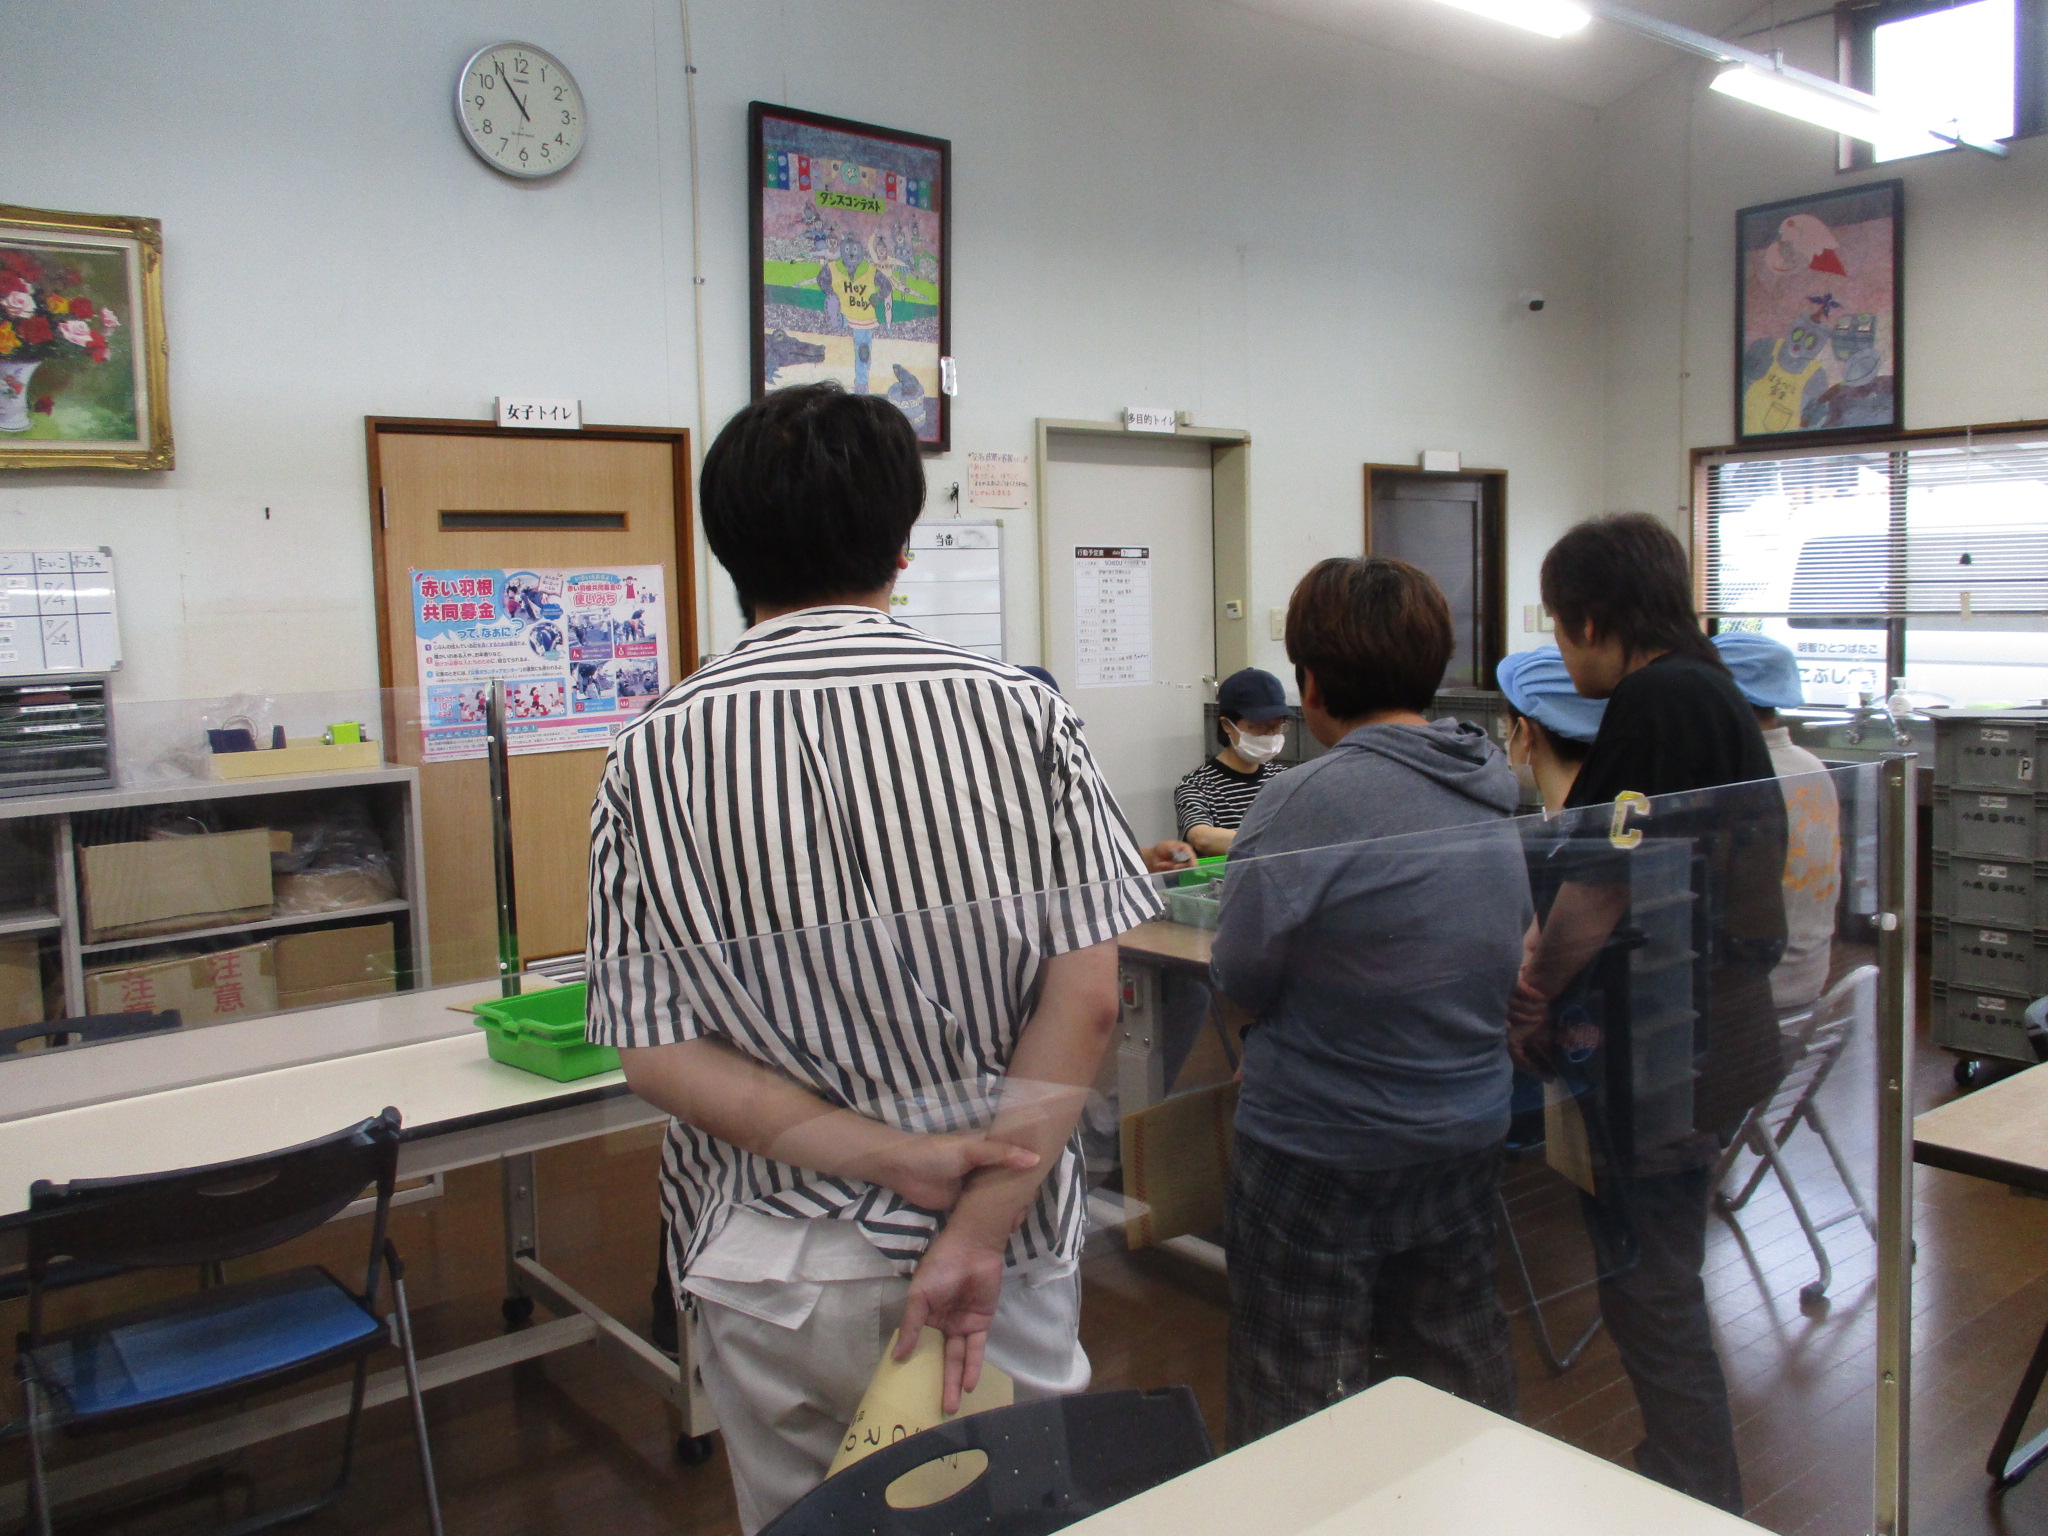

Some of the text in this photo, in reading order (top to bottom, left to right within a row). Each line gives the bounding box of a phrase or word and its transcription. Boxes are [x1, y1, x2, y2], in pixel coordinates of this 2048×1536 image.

[515, 58, 528, 74] 12
[480, 74, 494, 90] 10
[540, 68, 545, 83] 1
[553, 86, 563, 101] 2
[475, 95, 485, 110] 9
[561, 110, 570, 125] 3
[483, 119, 492, 134] 8
[500, 137, 508, 152] 7
[555, 132, 563, 145] 4
[519, 147, 528, 161] 6
[540, 143, 550, 157] 5
[820, 191, 881, 213] ダンスコンテスト
[844, 281, 867, 296] Hey
[849, 295, 871, 311] Baby
[506, 404, 572, 421] 女子トイレ
[1127, 412, 1176, 426] 多目的トイレ
[935, 532, 954, 547] 当番
[421, 579, 494, 598] 赤い羽根
[574, 593, 617, 606] 使いみち
[423, 602, 495, 621] 共同募金
[2021, 760, 2031, 777] P
[209, 952, 246, 1014] 注意
